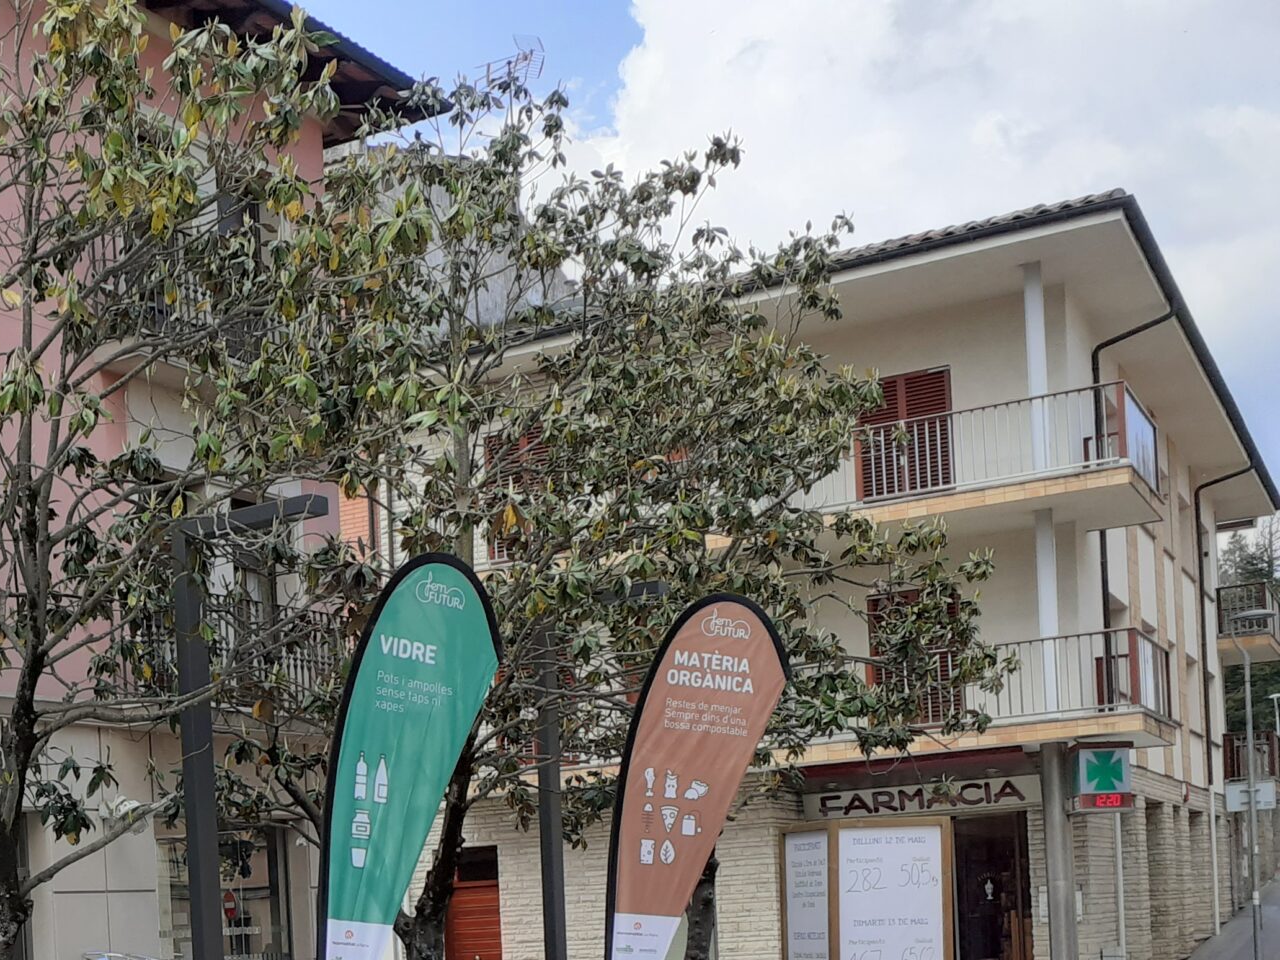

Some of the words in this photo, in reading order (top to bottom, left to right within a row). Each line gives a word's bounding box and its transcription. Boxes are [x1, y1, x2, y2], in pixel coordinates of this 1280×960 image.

[429, 592, 461, 609] FUTUR
[715, 625, 746, 638] FUTUR
[380, 634, 437, 664] VIDRE
[674, 650, 750, 674] MATÈRIA
[377, 670, 399, 685] Pots
[407, 678, 453, 696] ampolles
[667, 668, 754, 694] ORGÀNICA
[376, 686, 405, 700] sense
[408, 691, 430, 706] taps
[431, 695, 441, 706] ni
[665, 697, 696, 710] Restes
[698, 700, 709, 711] de
[375, 699, 404, 713] xapes
[664, 708, 700, 721] Sempre
[701, 711, 720, 723] dins
[664, 719, 690, 730] bossa
[691, 722, 748, 737] compostable
[819, 780, 1026, 817] FARMACIA
[907, 836, 926, 844] MAIG
[845, 867, 887, 893] 282
